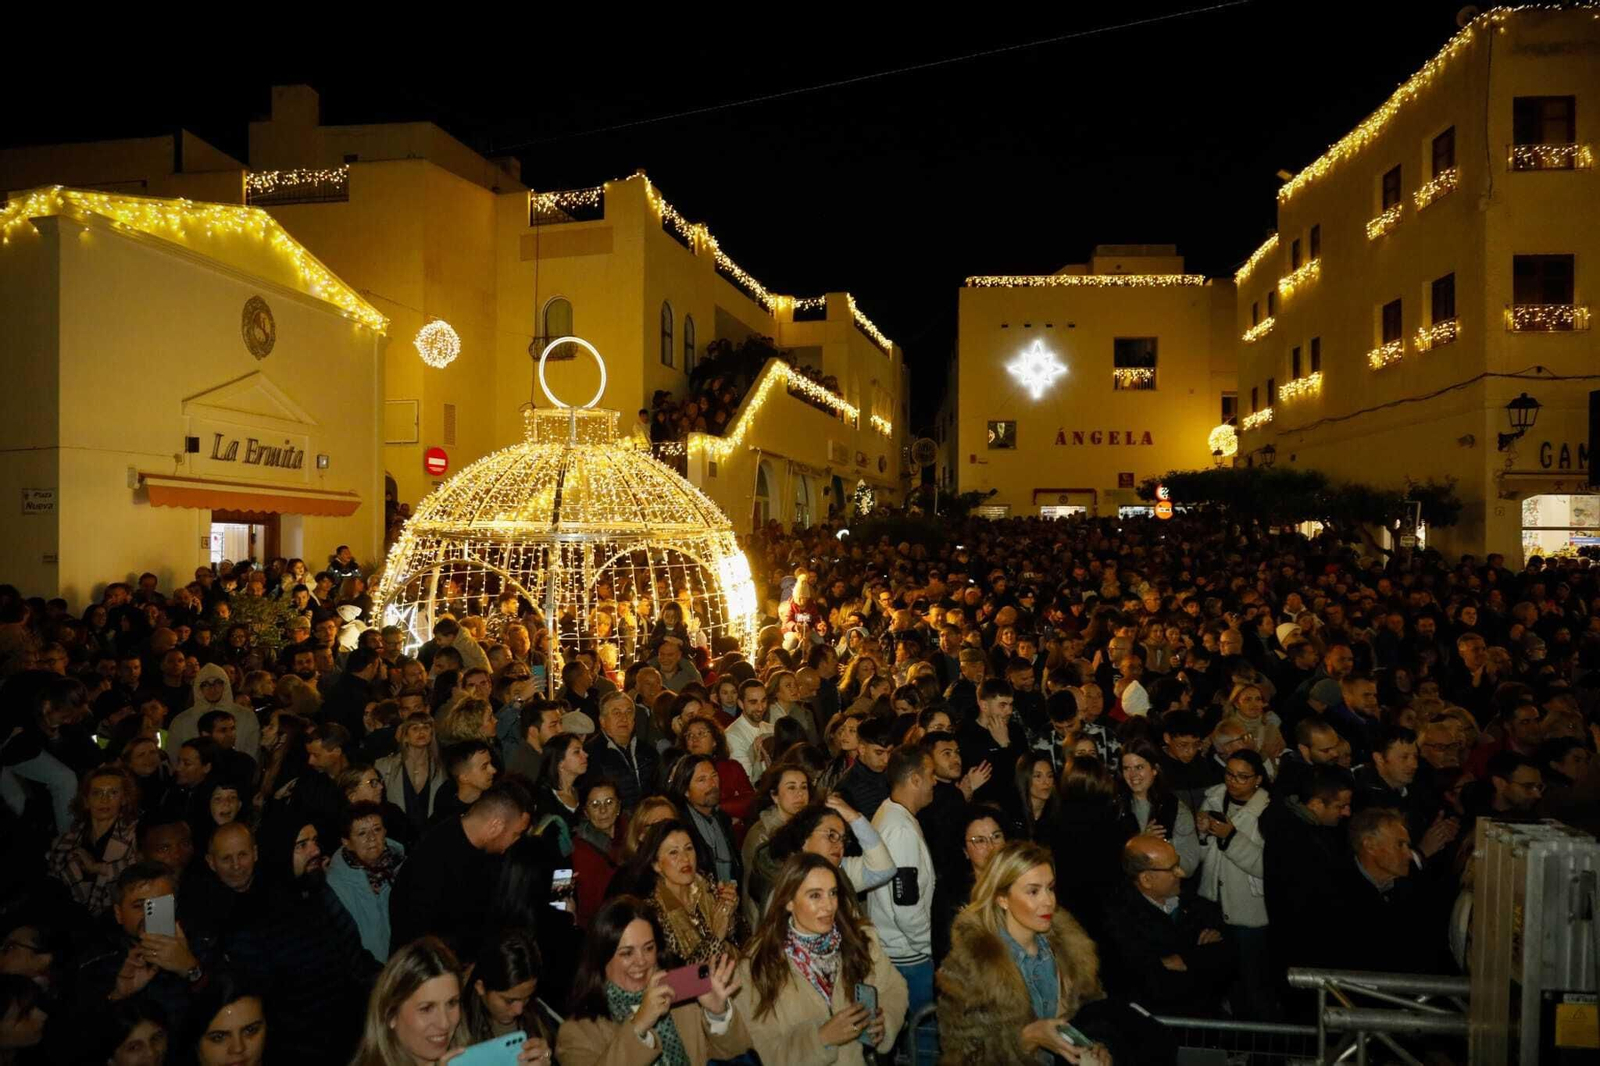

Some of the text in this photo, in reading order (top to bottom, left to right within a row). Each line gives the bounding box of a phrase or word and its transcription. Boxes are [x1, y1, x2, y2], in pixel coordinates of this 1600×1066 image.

[1055, 427, 1154, 446] ÁNGELA
[210, 432, 304, 470] La Ermita
[25, 501, 54, 511] Nueva
